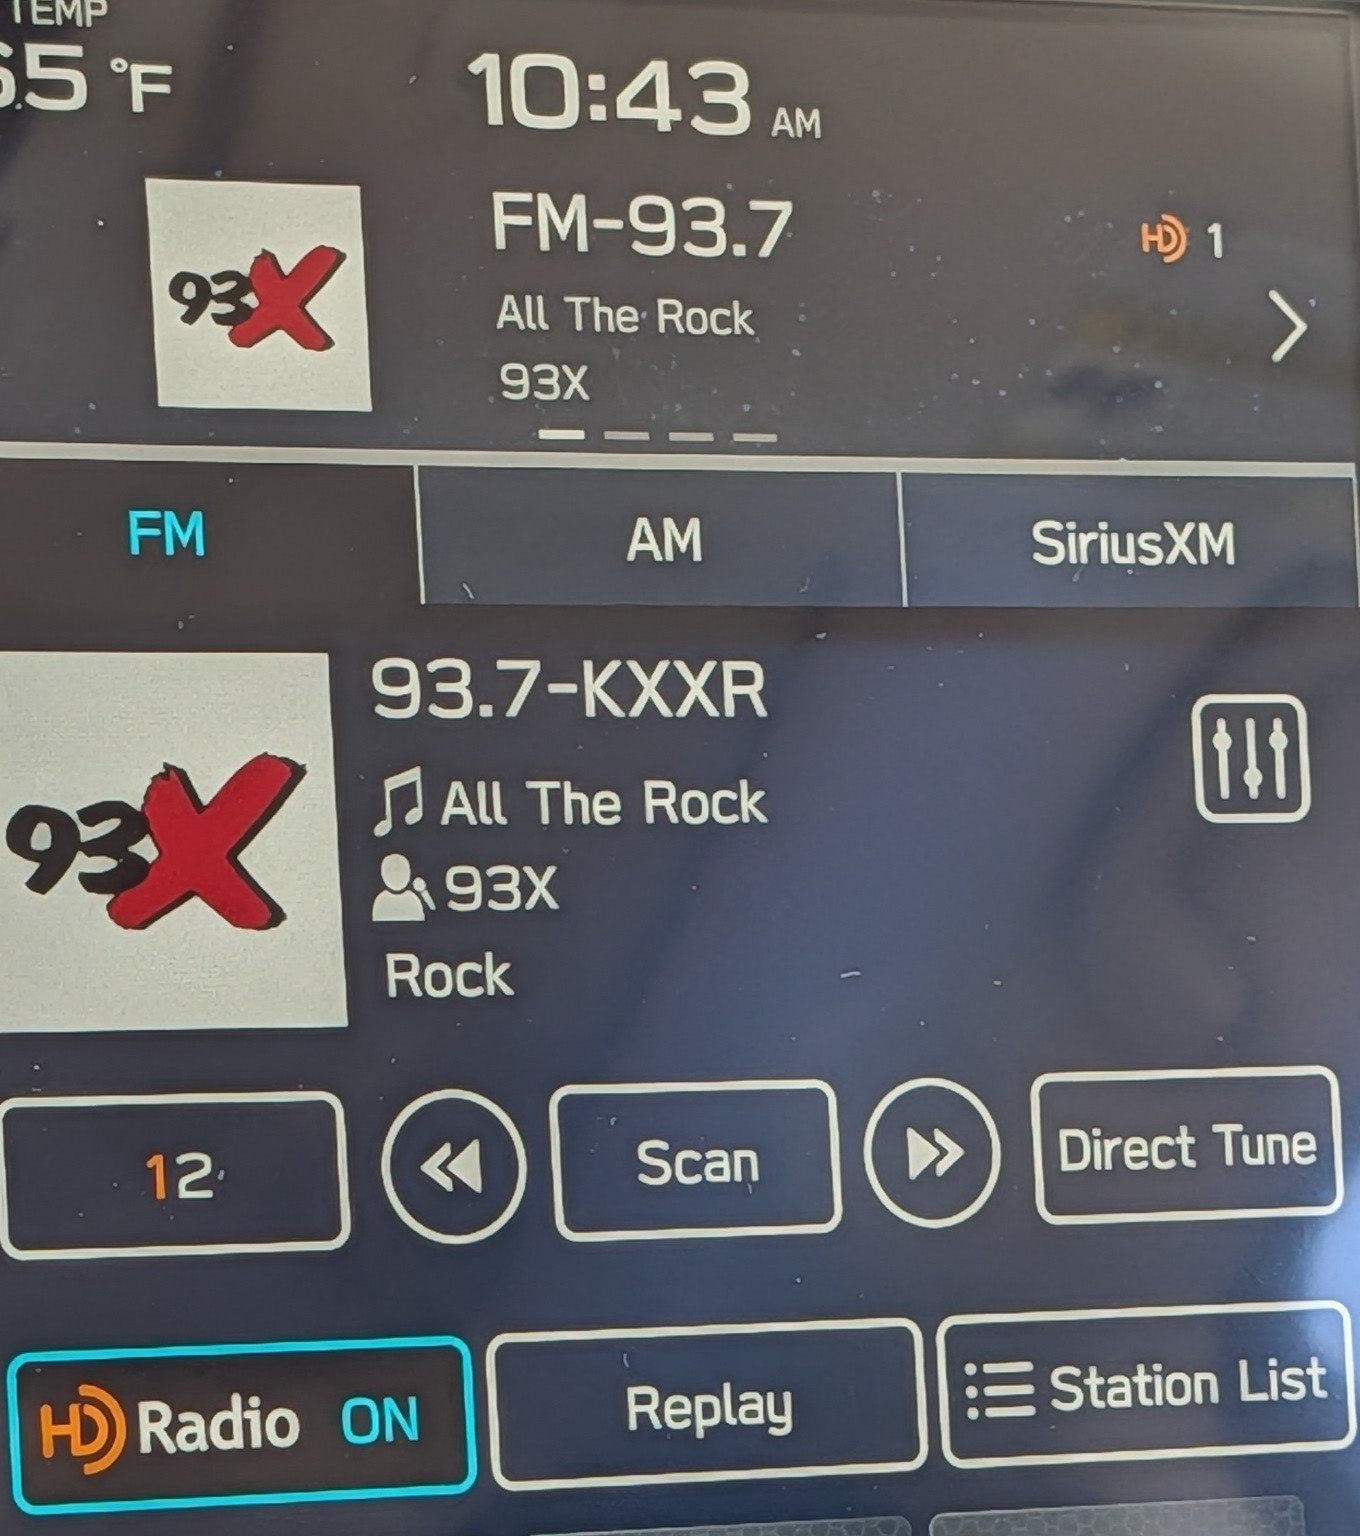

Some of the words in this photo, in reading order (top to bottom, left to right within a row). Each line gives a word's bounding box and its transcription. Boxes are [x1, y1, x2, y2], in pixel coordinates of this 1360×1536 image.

[13, 0, 108, 28] TEMP
[467, 53, 752, 138] 10:43
[771, 108, 822, 141] AM
[491, 193, 794, 260] FM-93.7
[1207, 223, 1224, 259] 1
[496, 294, 549, 334] All
[564, 296, 640, 335] The
[657, 299, 756, 339] Rock
[500, 364, 590, 403] 93X
[127, 510, 206, 556] FM
[626, 517, 704, 563] AM
[1031, 520, 1236, 568] SiriusXM
[371, 656, 769, 720] 93.7-KXXR
[440, 779, 508, 828] All
[526, 780, 622, 827] The
[644, 778, 769, 827] Rock
[446, 864, 560, 912] 93X
[386, 951, 515, 999] Rock
[636, 1138, 761, 1188] Scan
[1058, 1125, 1198, 1174] Direct
[1212, 1121, 1318, 1168] Tune
[1048, 1361, 1220, 1413] Station
[1238, 1356, 1329, 1404] List
[137, 1392, 300, 1455] Radio
[341, 1394, 420, 1446] ON
[626, 1382, 794, 1440] Replay
